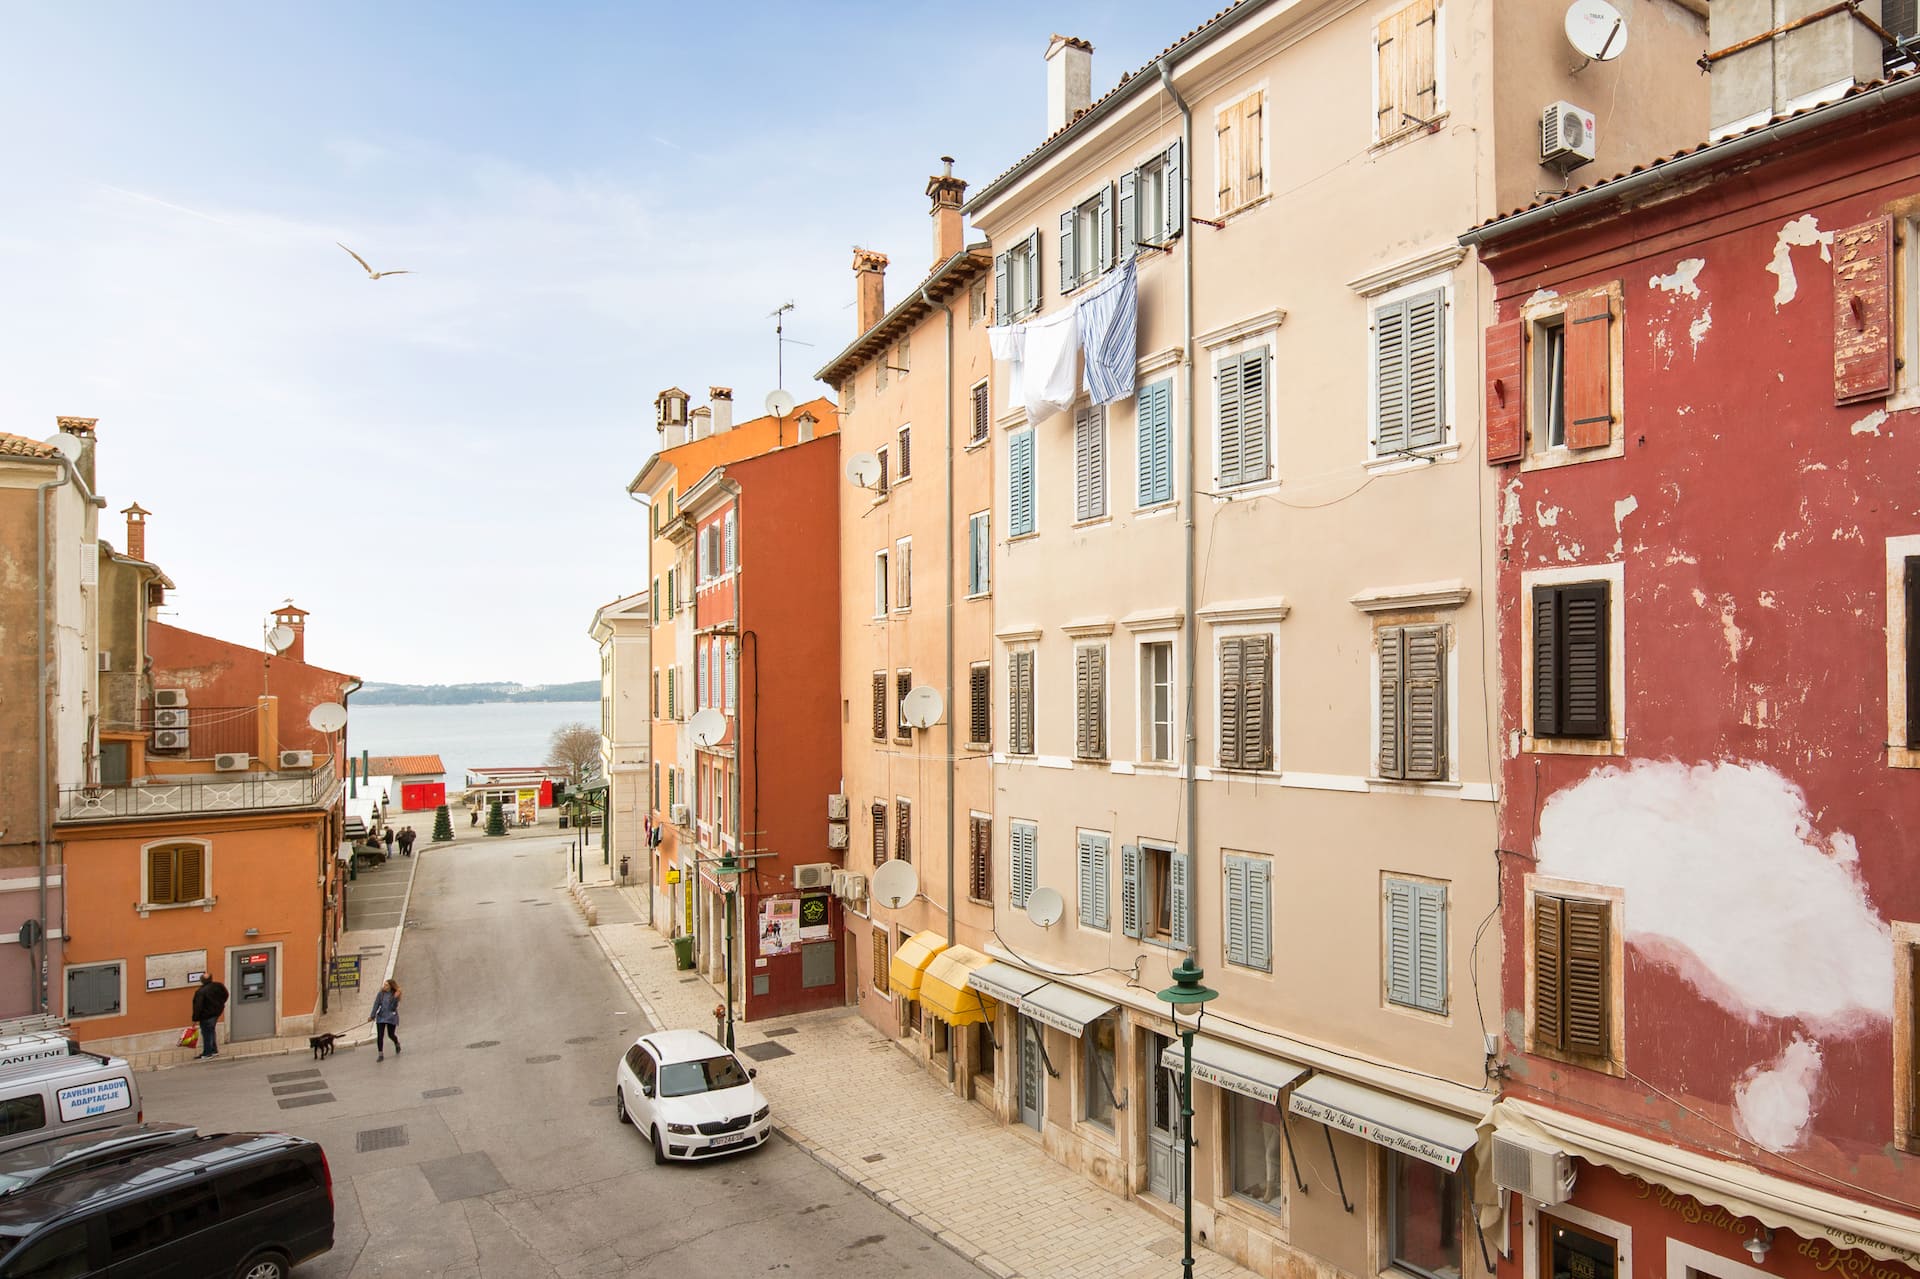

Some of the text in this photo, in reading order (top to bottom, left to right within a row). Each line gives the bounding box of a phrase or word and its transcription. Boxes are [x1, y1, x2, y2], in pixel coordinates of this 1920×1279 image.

[1, 1050, 62, 1066] ANTENE
[71, 1091, 119, 1107] ADAPTACIJE
[1294, 1100, 1321, 1118] Boutique
[1370, 1127, 1395, 1146] Luxury
[1417, 1144, 1443, 1161] Fashion
[1797, 1239, 1820, 1259] da
